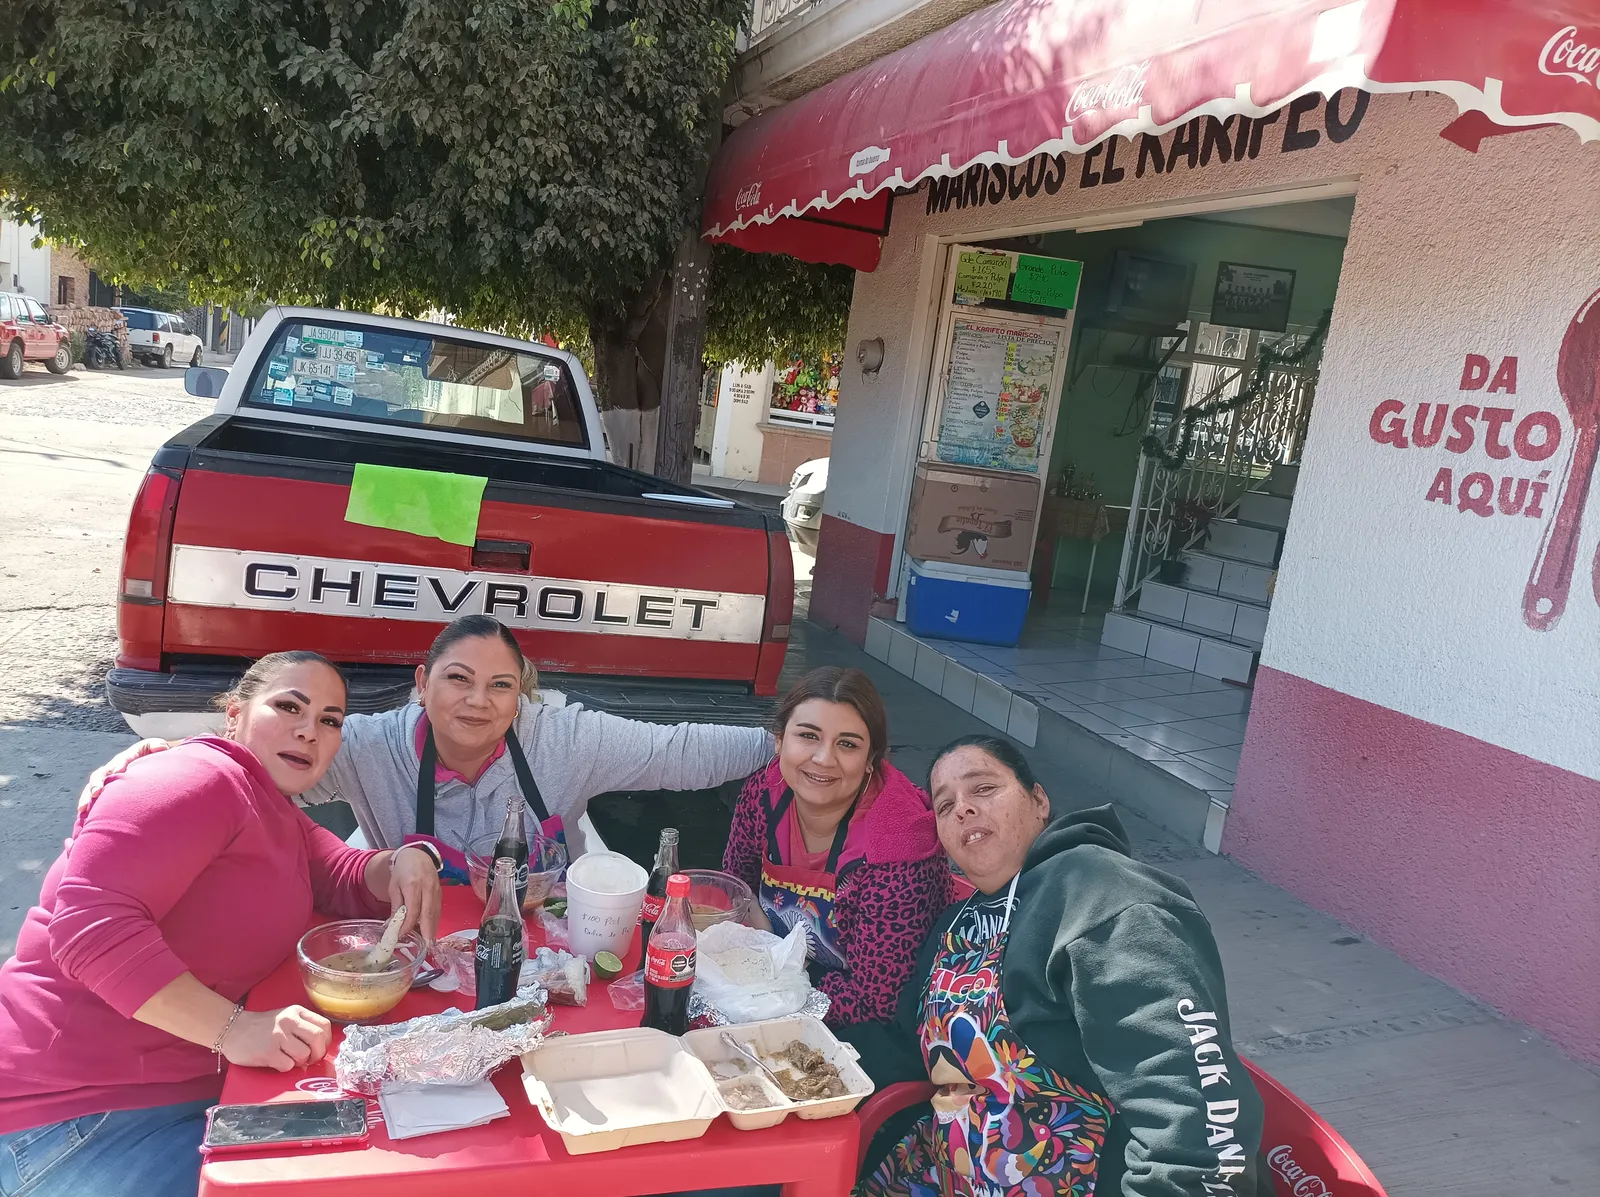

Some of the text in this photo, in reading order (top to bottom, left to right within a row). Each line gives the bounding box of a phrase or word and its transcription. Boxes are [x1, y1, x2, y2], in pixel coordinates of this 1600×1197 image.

[1080, 134, 1124, 188] EL
[1018, 258, 1045, 274] Grande
[1006, 329, 1043, 340] MARISCOS
[1460, 353, 1518, 394] DA
[1369, 399, 1562, 461] GUSTO
[1425, 467, 1551, 518] AQUÍ
[243, 561, 719, 630] CHEVROLET
[1177, 998, 1231, 1089] JACK
